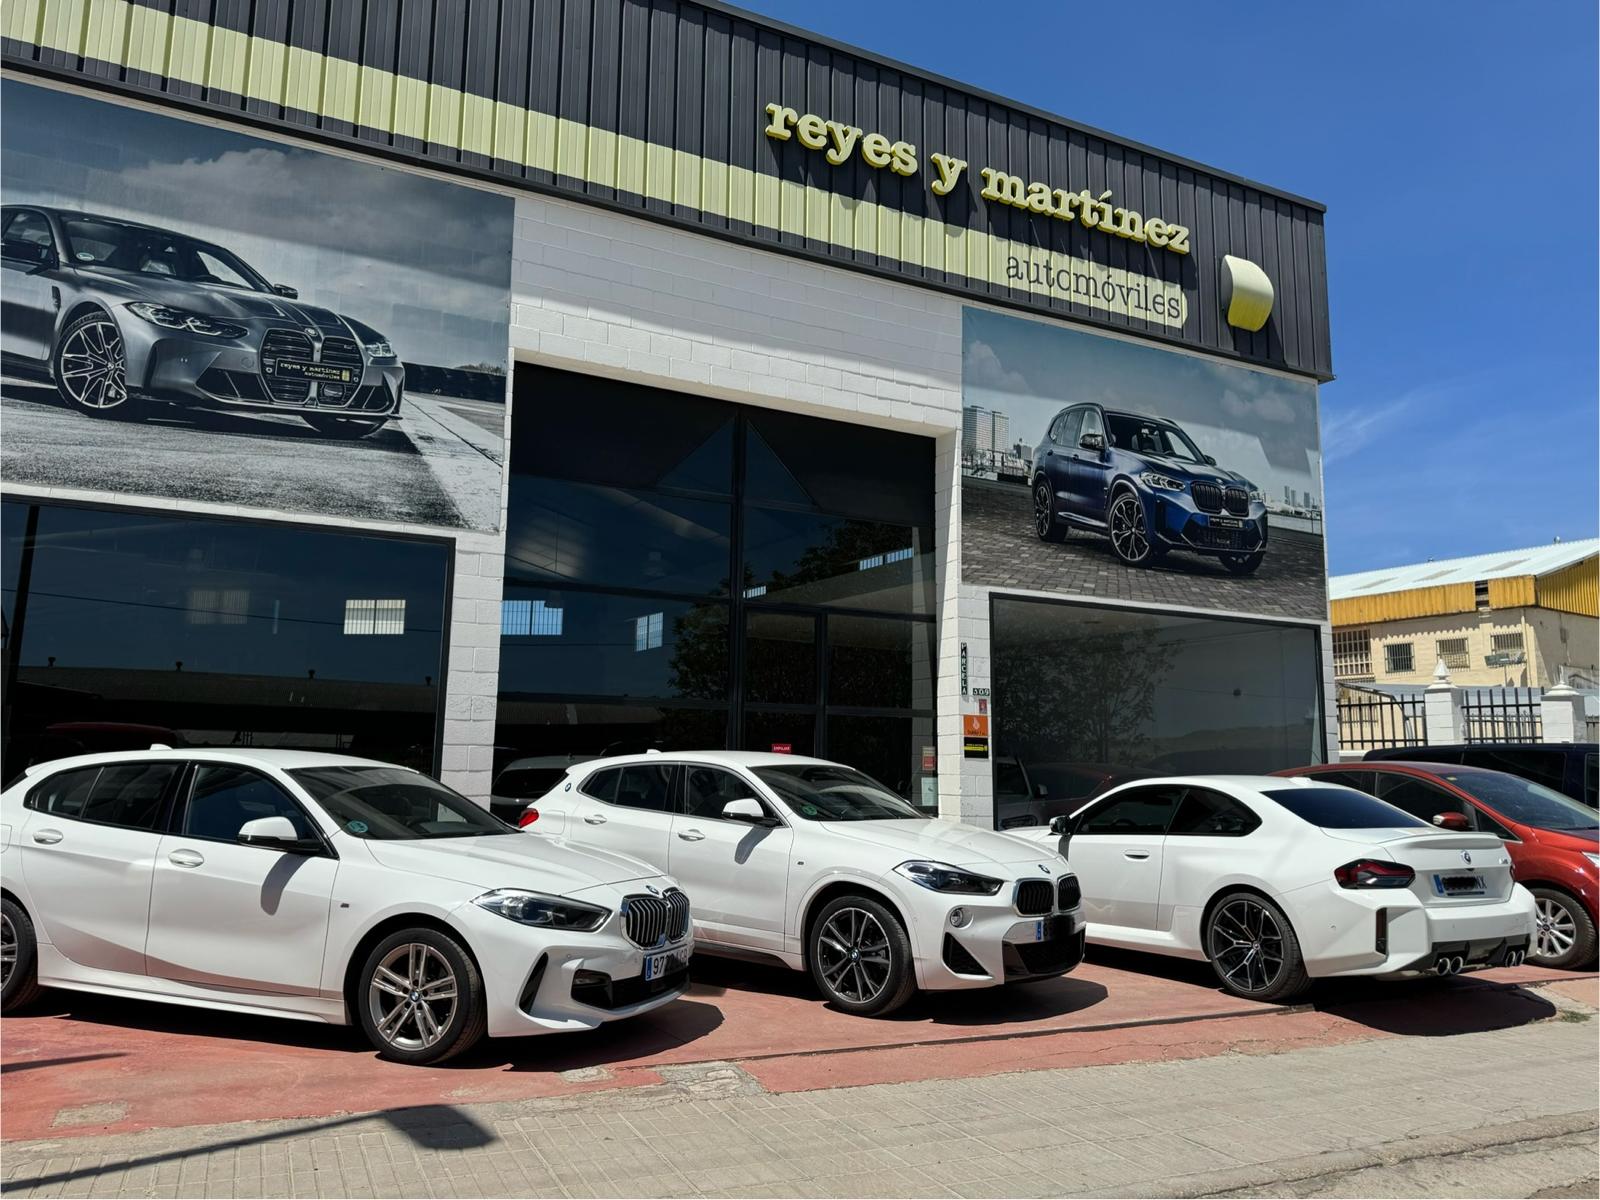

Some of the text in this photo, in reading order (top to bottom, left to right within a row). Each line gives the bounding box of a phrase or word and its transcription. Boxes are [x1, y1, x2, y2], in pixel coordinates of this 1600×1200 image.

[765, 102, 1190, 255] reyes y martínez
[1006, 256, 1181, 319] automóviles
